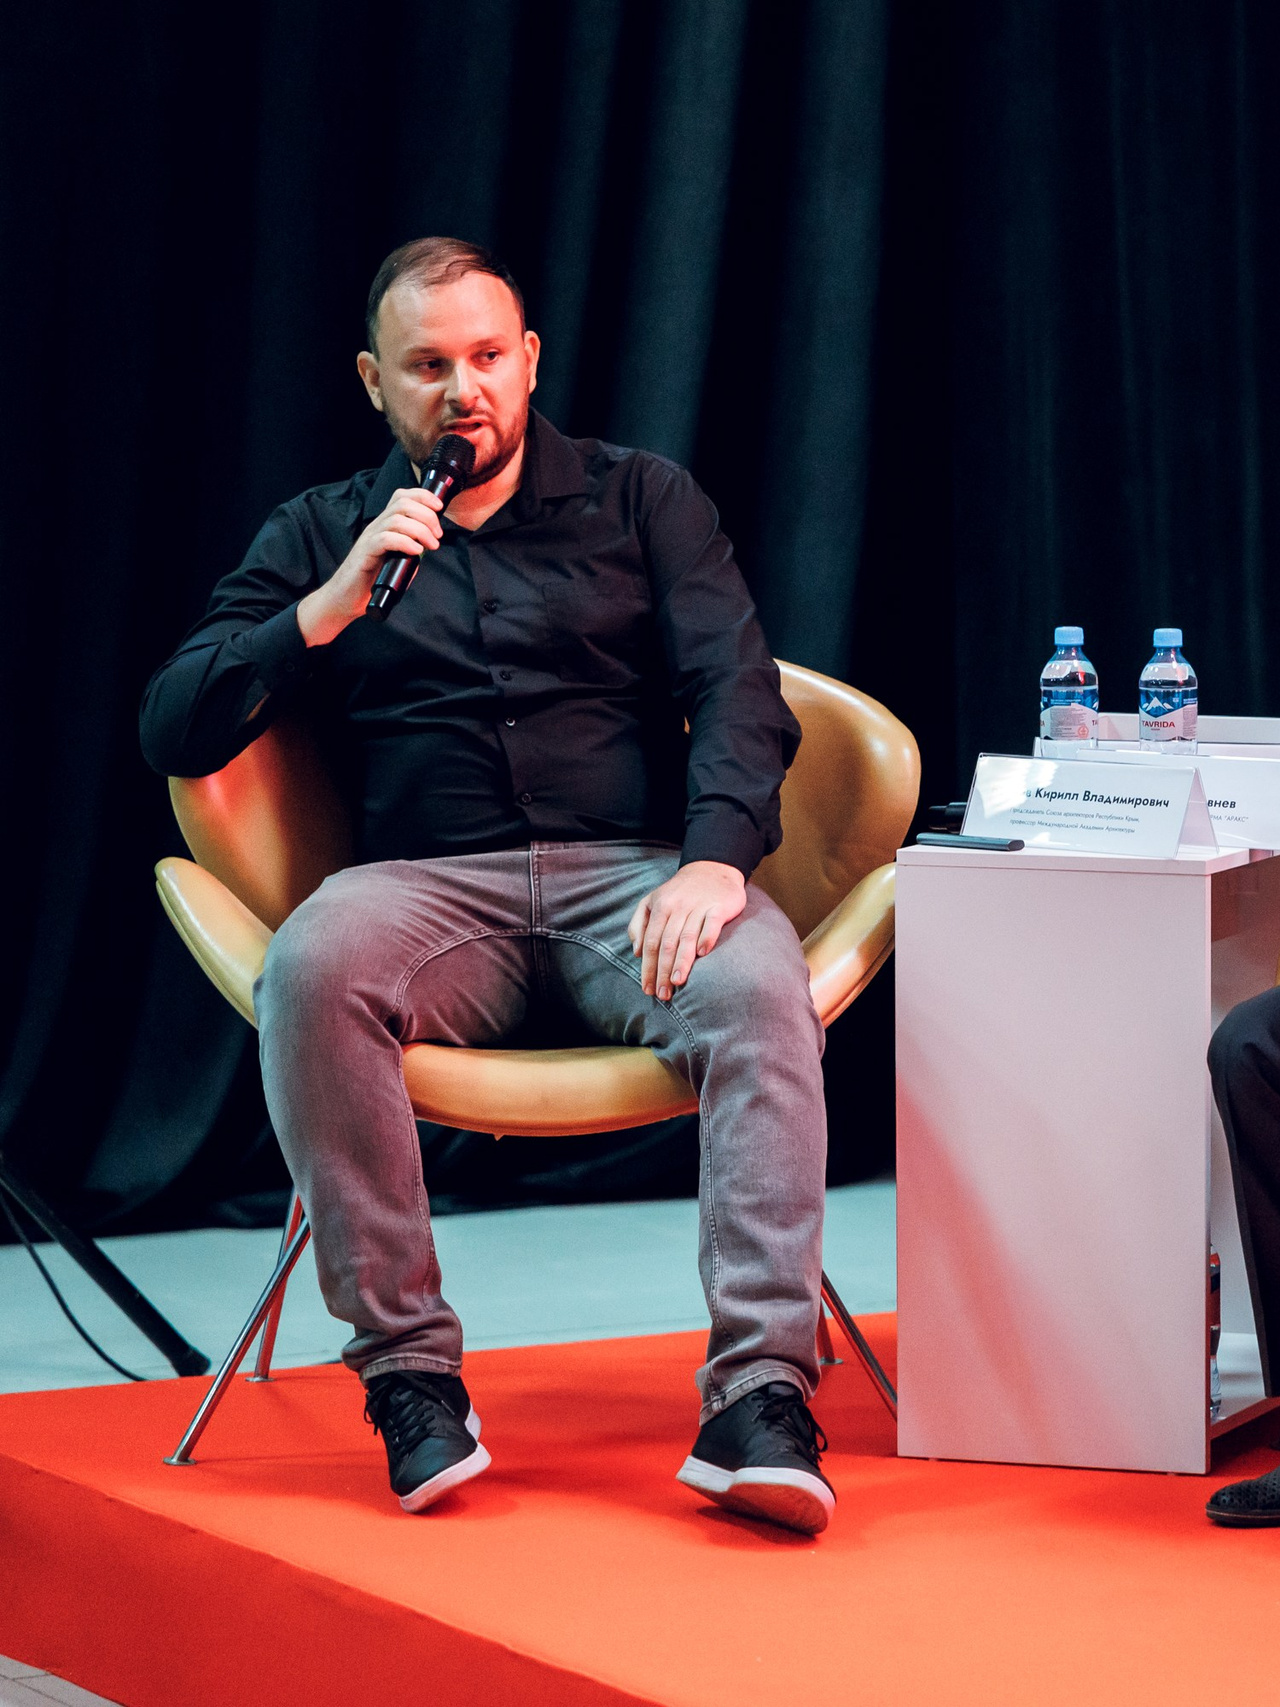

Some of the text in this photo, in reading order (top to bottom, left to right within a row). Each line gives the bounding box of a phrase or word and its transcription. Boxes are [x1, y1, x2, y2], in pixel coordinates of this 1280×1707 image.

[1142, 720, 1176, 728] TAVRIDA
[1035, 787, 1079, 803] Кирилл
[1082, 790, 1170, 808] Владимирович
[1207, 799, 1237, 809] внев
